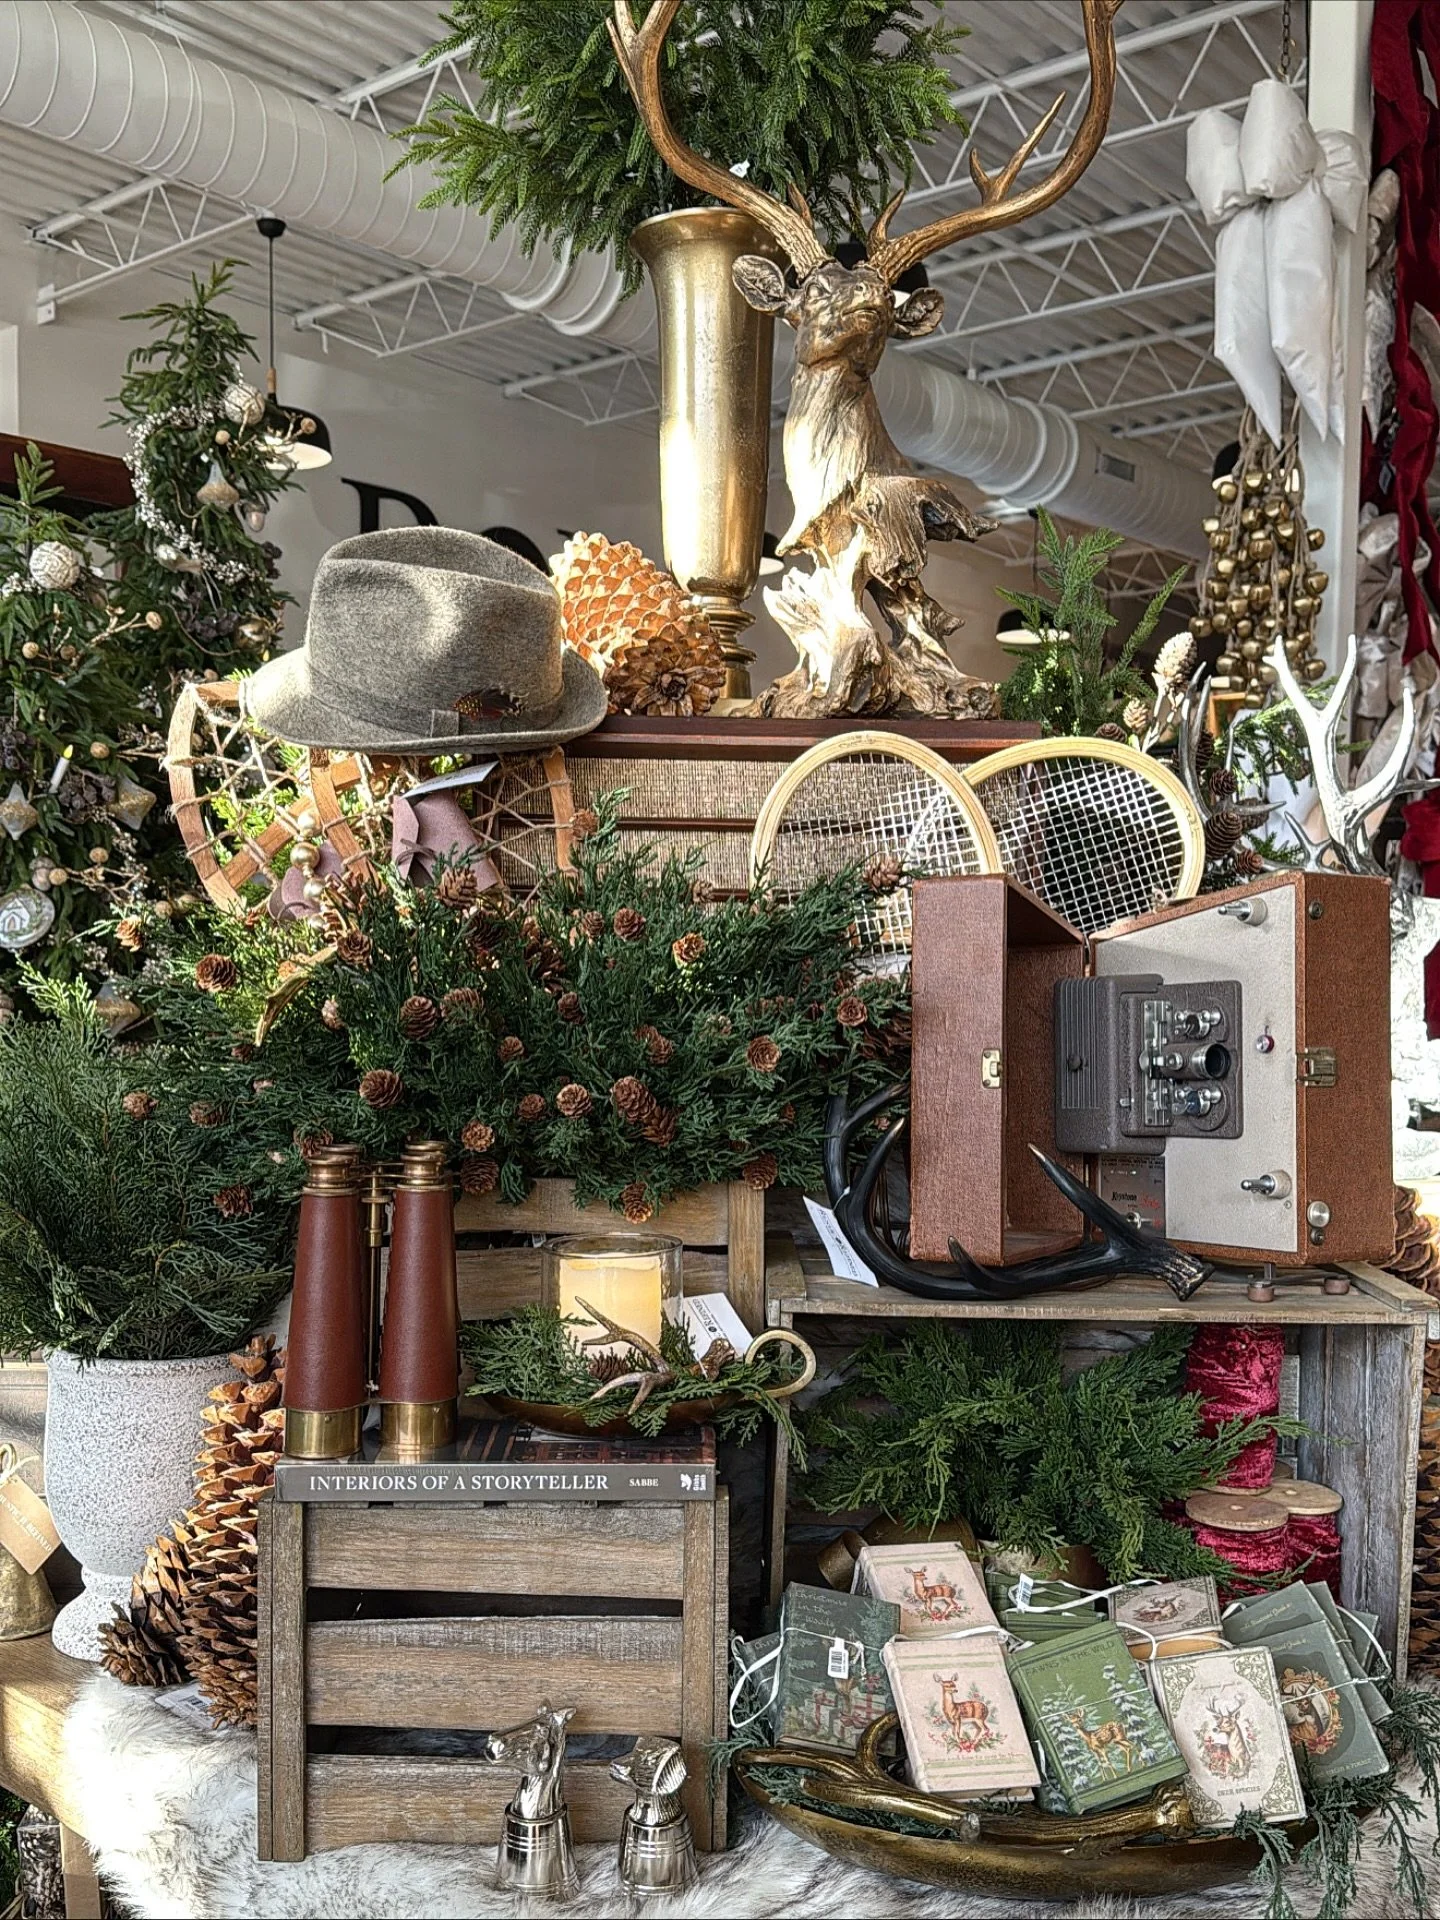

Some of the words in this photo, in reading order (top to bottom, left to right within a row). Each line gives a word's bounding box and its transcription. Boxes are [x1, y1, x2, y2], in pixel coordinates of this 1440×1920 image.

[309, 1475, 418, 1491] INTERIORS
[422, 1475, 449, 1491] OF
[453, 1475, 467, 1491] A
[471, 1474, 609, 1491] STORYTELLER
[629, 1478, 660, 1488] SABBE
[1026, 1662, 1060, 1676] FAWNS
[1071, 1650, 1089, 1661] THE
[1091, 1640, 1115, 1655] WILD
